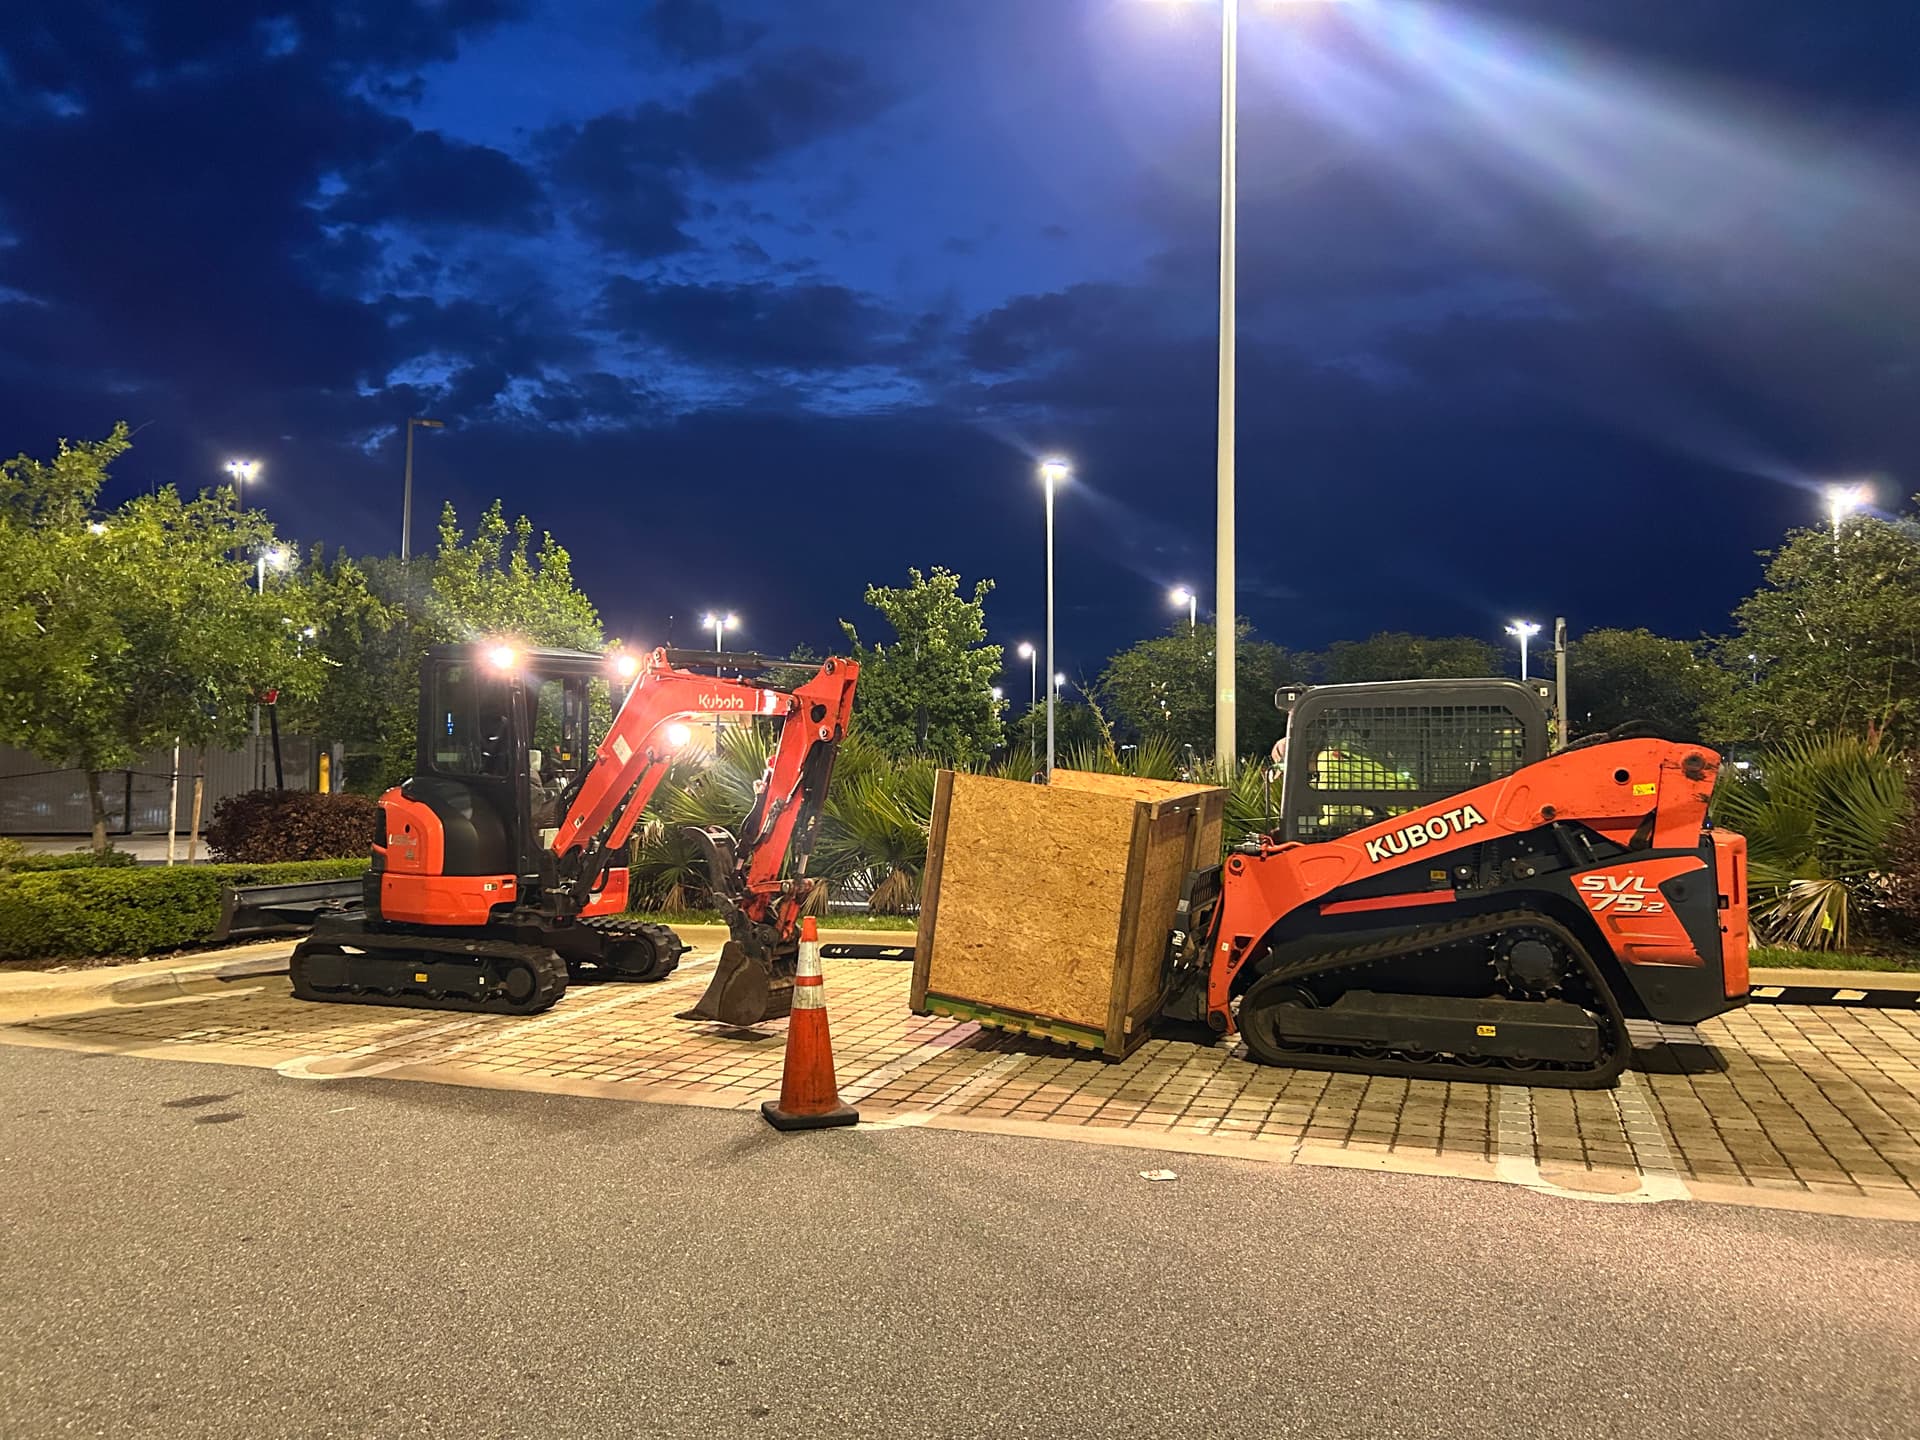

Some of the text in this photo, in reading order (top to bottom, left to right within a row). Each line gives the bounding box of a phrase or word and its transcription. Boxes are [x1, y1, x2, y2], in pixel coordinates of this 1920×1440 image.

[698, 693, 744, 709] Kubota
[1365, 804, 1486, 863] KUBOTA
[1579, 875, 1657, 892] SVL
[1591, 894, 1665, 912] 75-2
